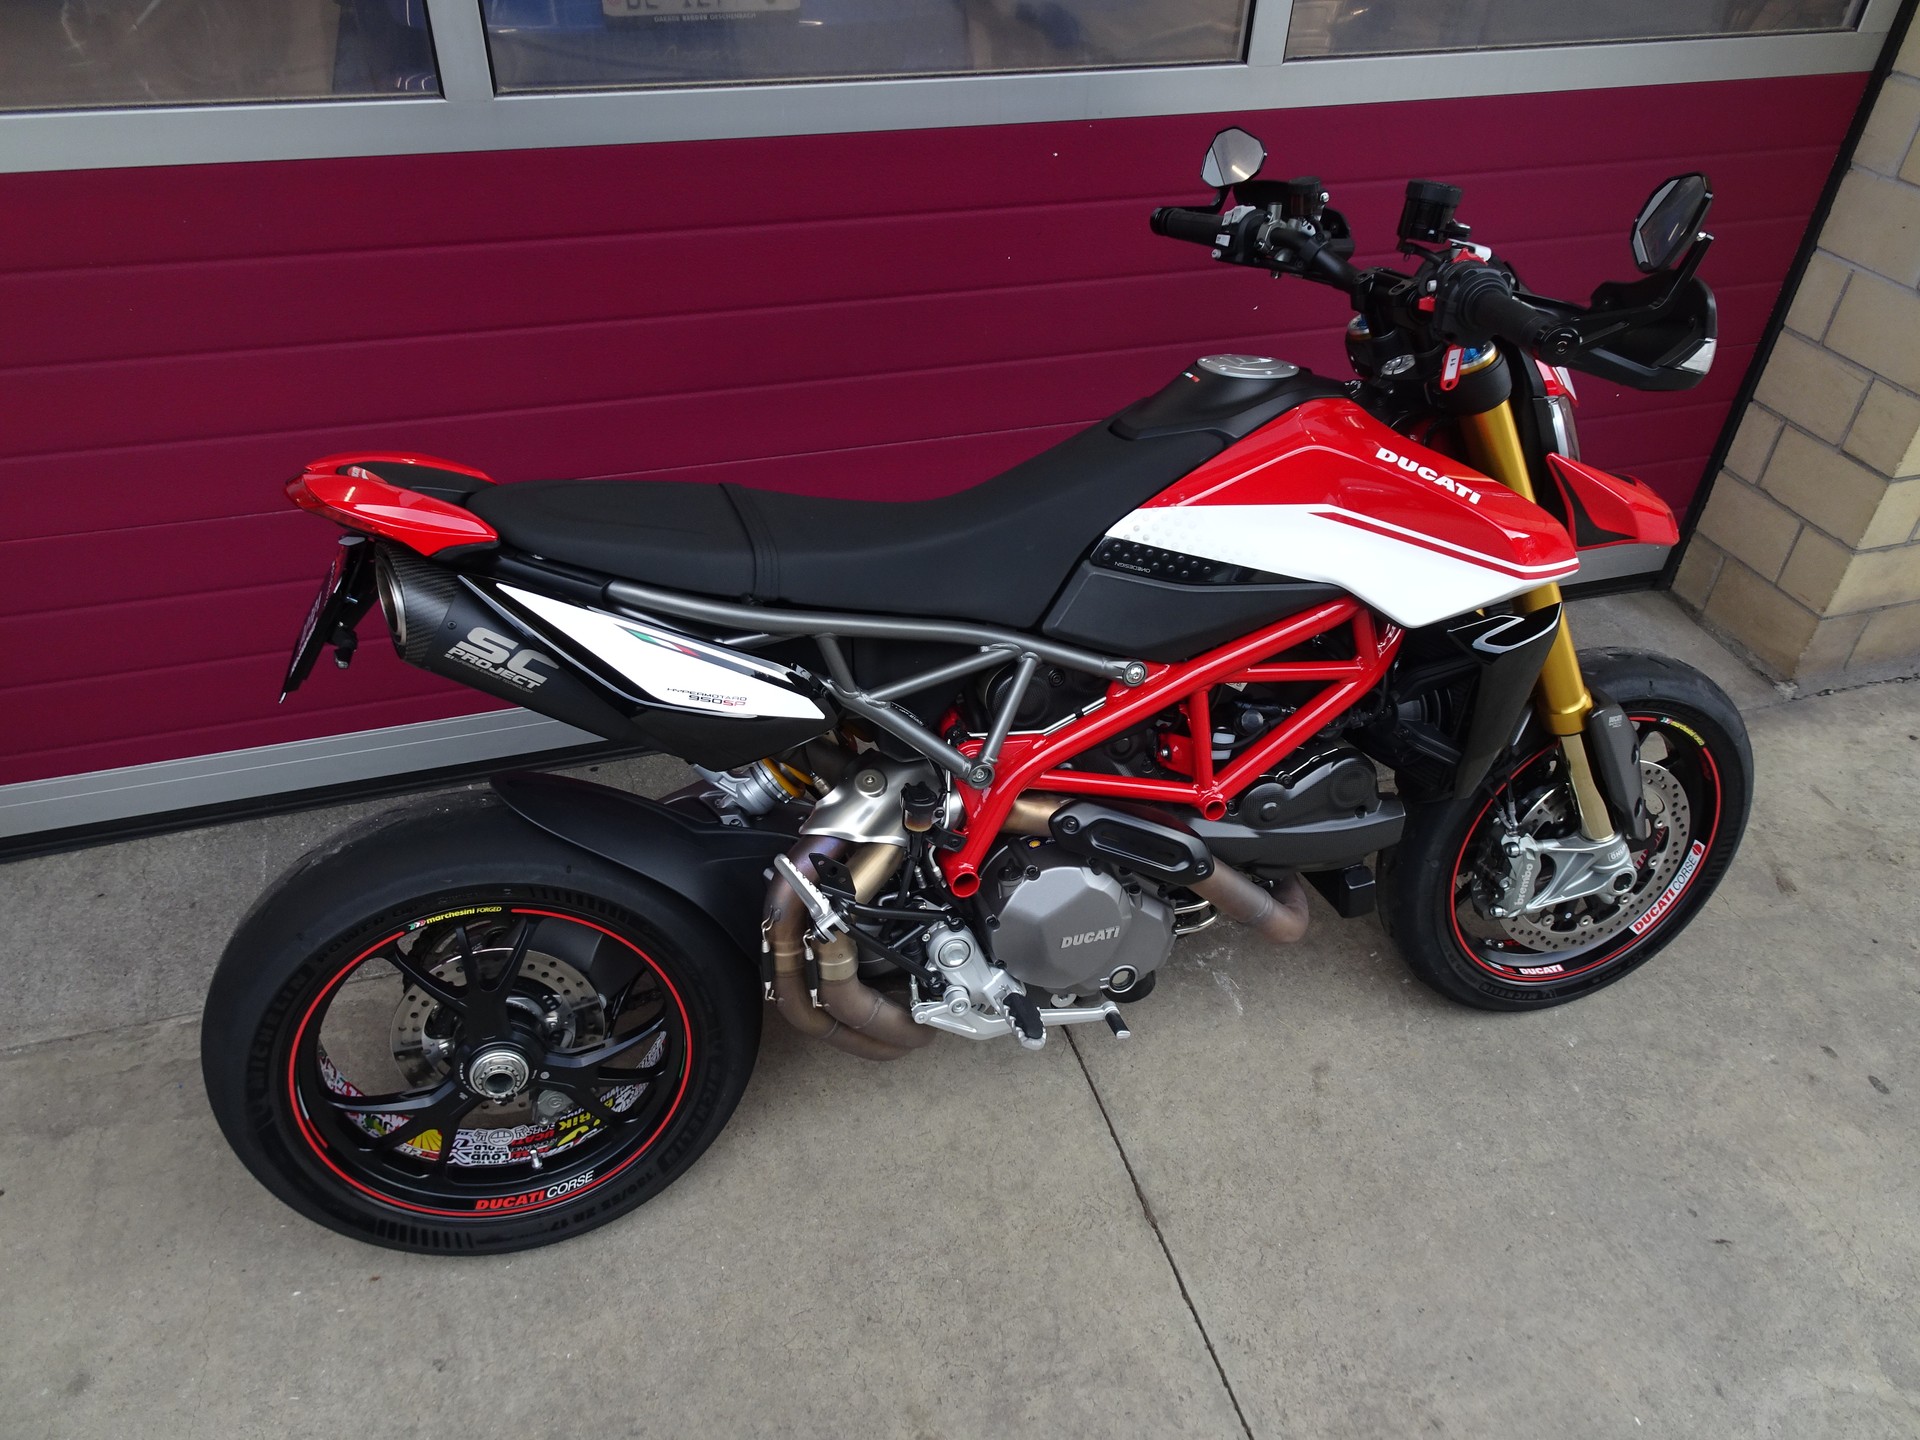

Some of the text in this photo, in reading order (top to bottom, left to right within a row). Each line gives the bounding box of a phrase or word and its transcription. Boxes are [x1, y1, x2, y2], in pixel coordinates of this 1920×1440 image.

[1375, 447, 1482, 505] DUCATI
[447, 646, 542, 689] PROJECT
[466, 626, 560, 684] SC
[688, 694, 747, 707] 950SP
[1513, 862, 1534, 906] brembo
[1633, 888, 1675, 932] DUCATI
[1672, 855, 1698, 891] CORSE
[427, 905, 503, 925] marchesini FORGED
[1061, 926, 1121, 950] DUCATI
[1518, 963, 1565, 976] DUCATI
[1481, 983, 1538, 1000] MICHELIN
[470, 1152, 509, 1160] LOUD
[474, 1170, 595, 1211] DUCATI CORSE
